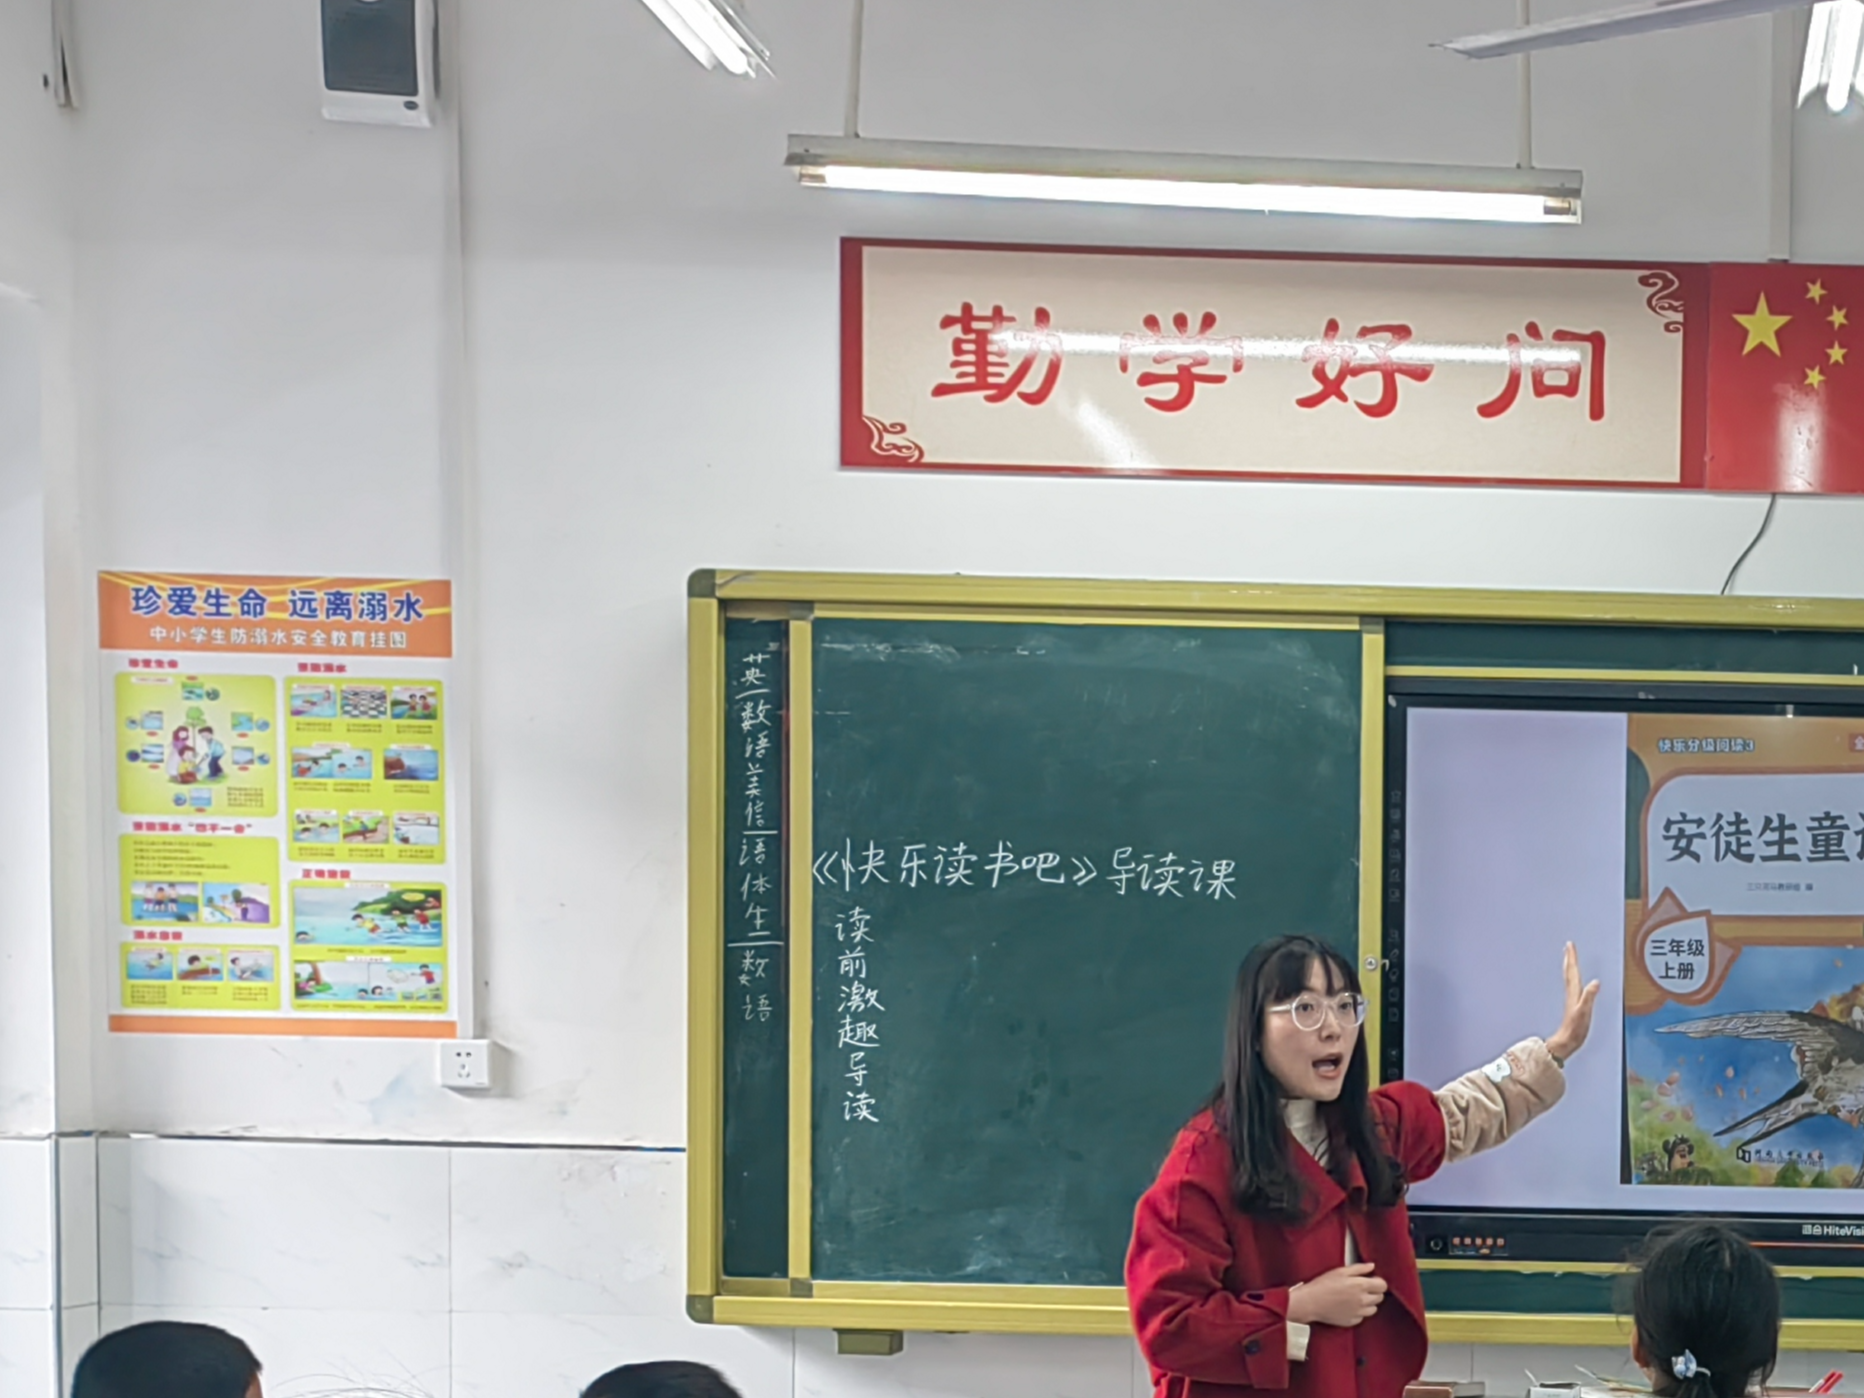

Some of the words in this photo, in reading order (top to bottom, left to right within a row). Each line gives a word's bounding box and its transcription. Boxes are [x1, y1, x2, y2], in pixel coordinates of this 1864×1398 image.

[931, 301, 1607, 422] 勤学好问
[130, 584, 268, 619] 珍爱生命
[288, 588, 424, 622] 远离溺水
[150, 626, 407, 649] 中小学生防溺水安全教育挂图
[1650, 938, 1705, 957] 三年级
[1658, 961, 1695, 980] 上册
